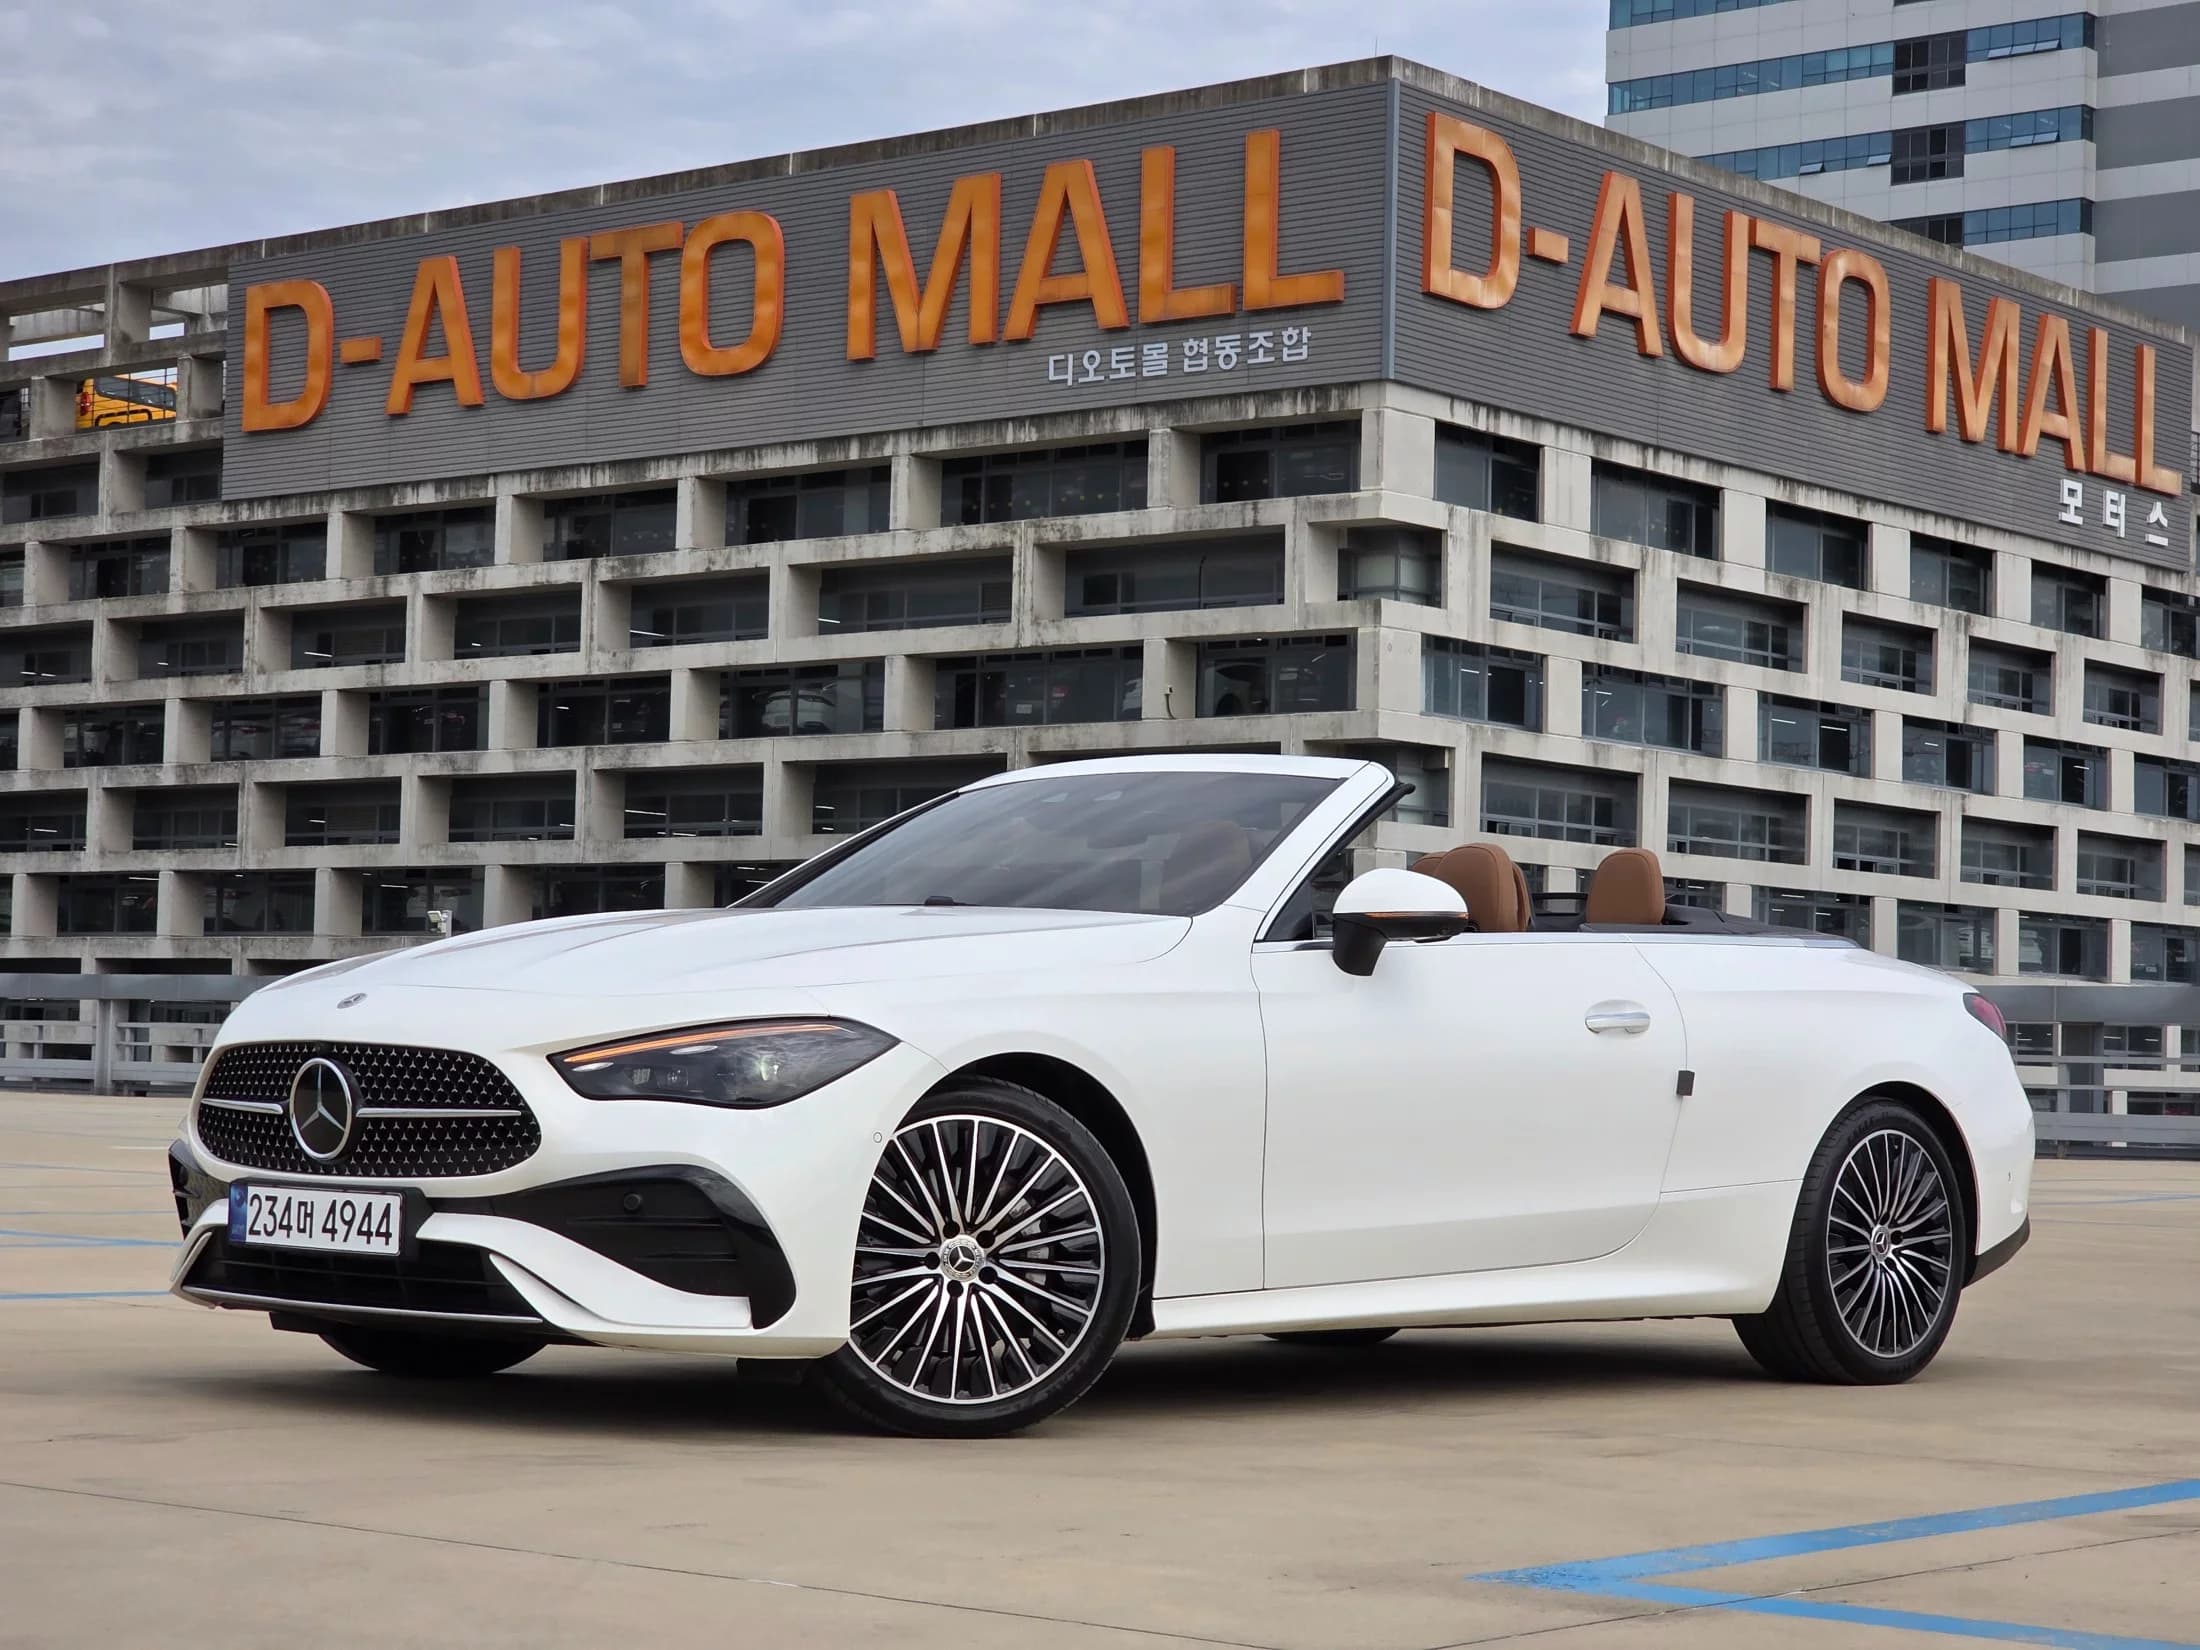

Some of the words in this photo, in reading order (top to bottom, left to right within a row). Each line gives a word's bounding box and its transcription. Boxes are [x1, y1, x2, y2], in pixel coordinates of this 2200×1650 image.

[242, 210, 785, 432] D-AUTO
[846, 128, 1345, 361] MALL
[1421, 111, 1892, 413] D-AUTO
[1926, 276, 2183, 497] MALL
[1048, 342, 1169, 386] 디오토몰
[1182, 326, 1312, 373] 협동조합
[2058, 478, 2169, 547] 모터스
[248, 1193, 315, 1239] 234머
[321, 1199, 393, 1246] 4944
